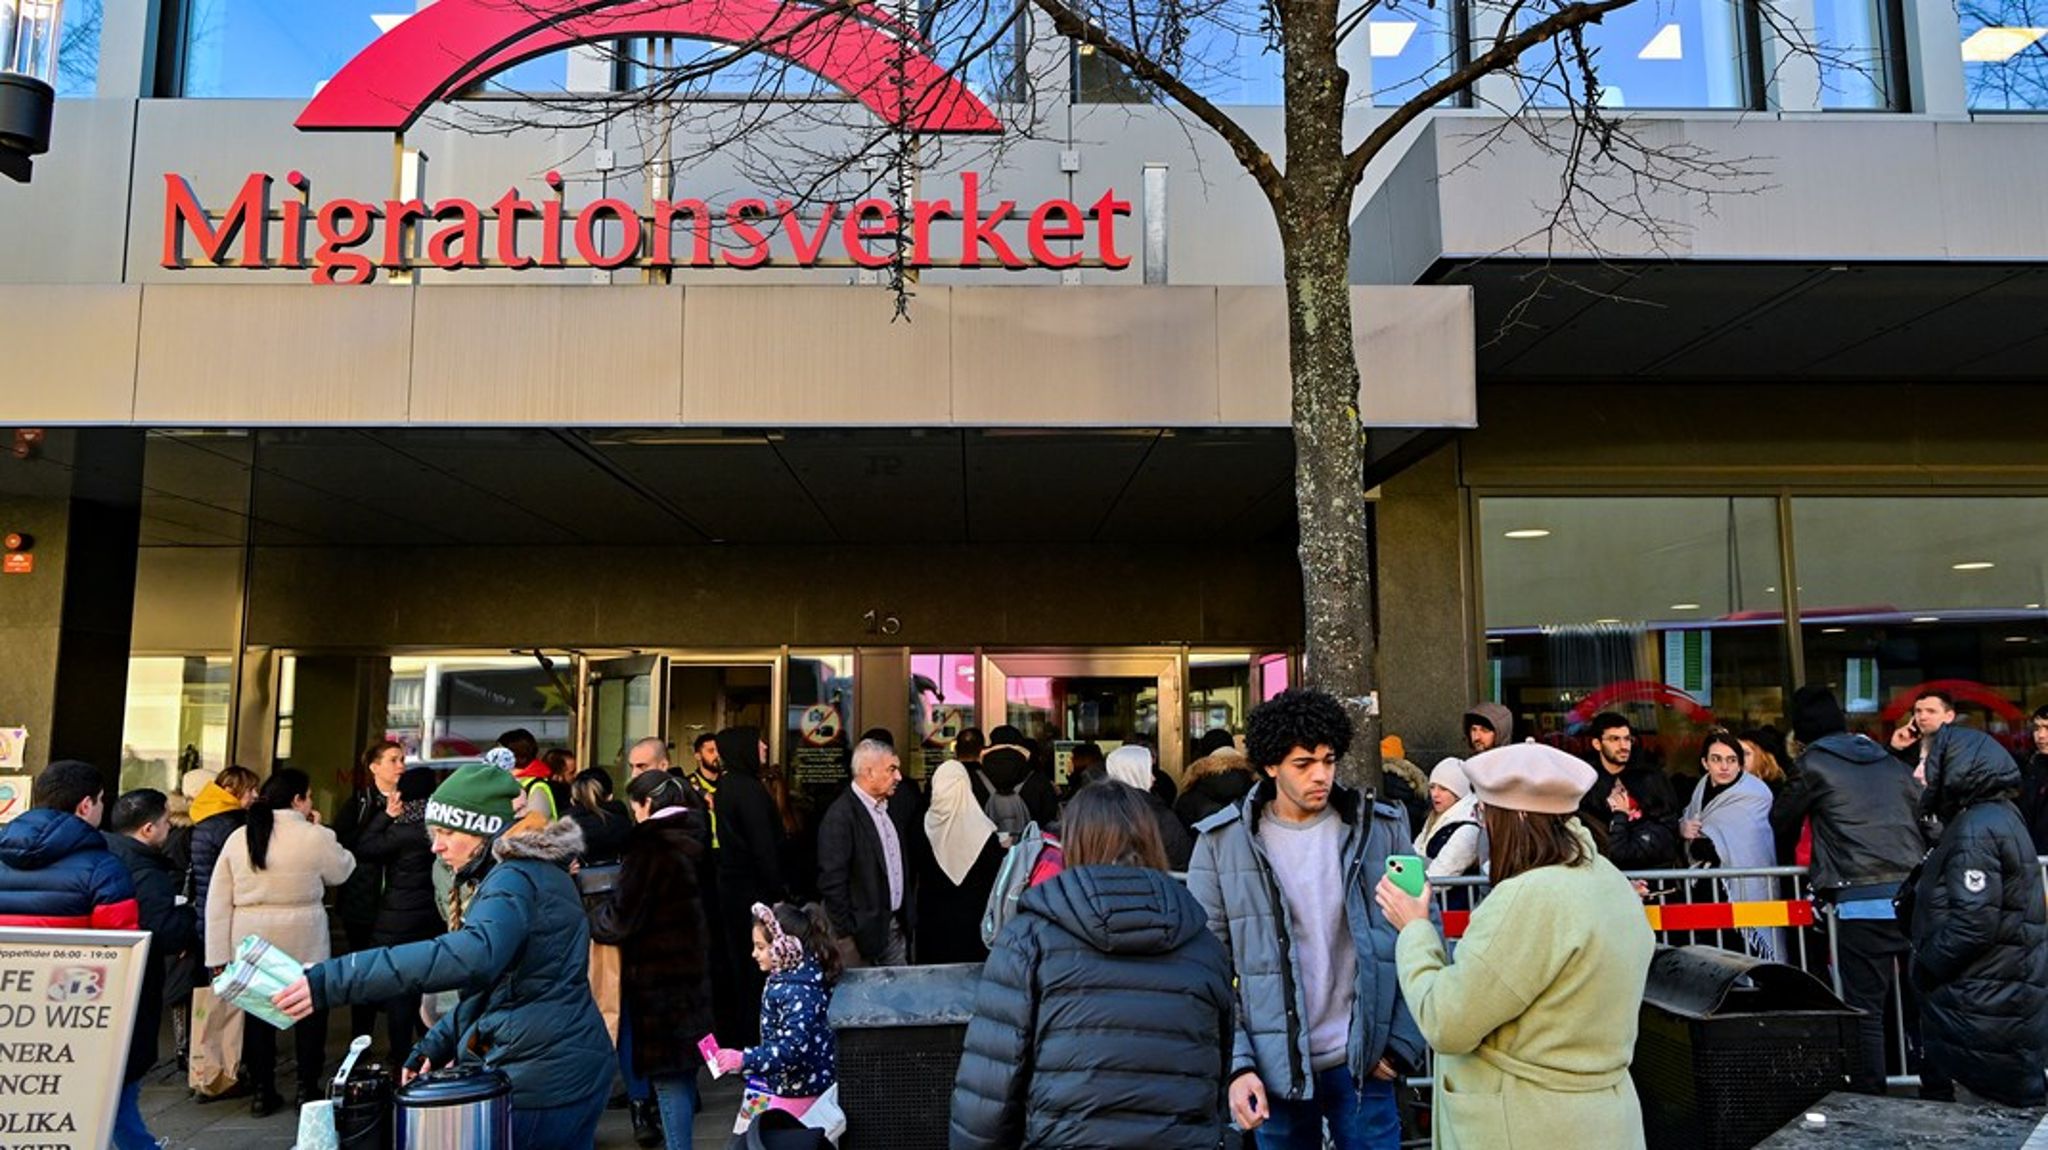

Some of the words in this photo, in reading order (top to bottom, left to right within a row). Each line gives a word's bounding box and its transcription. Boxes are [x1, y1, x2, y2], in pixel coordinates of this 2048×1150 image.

[160, 171, 1133, 285] Migrationsverket
[0, 949, 50, 959] ppettider
[0, 969, 35, 992] FE
[45, 1005, 112, 1029] WISE
[0, 1074, 62, 1095] NCH
